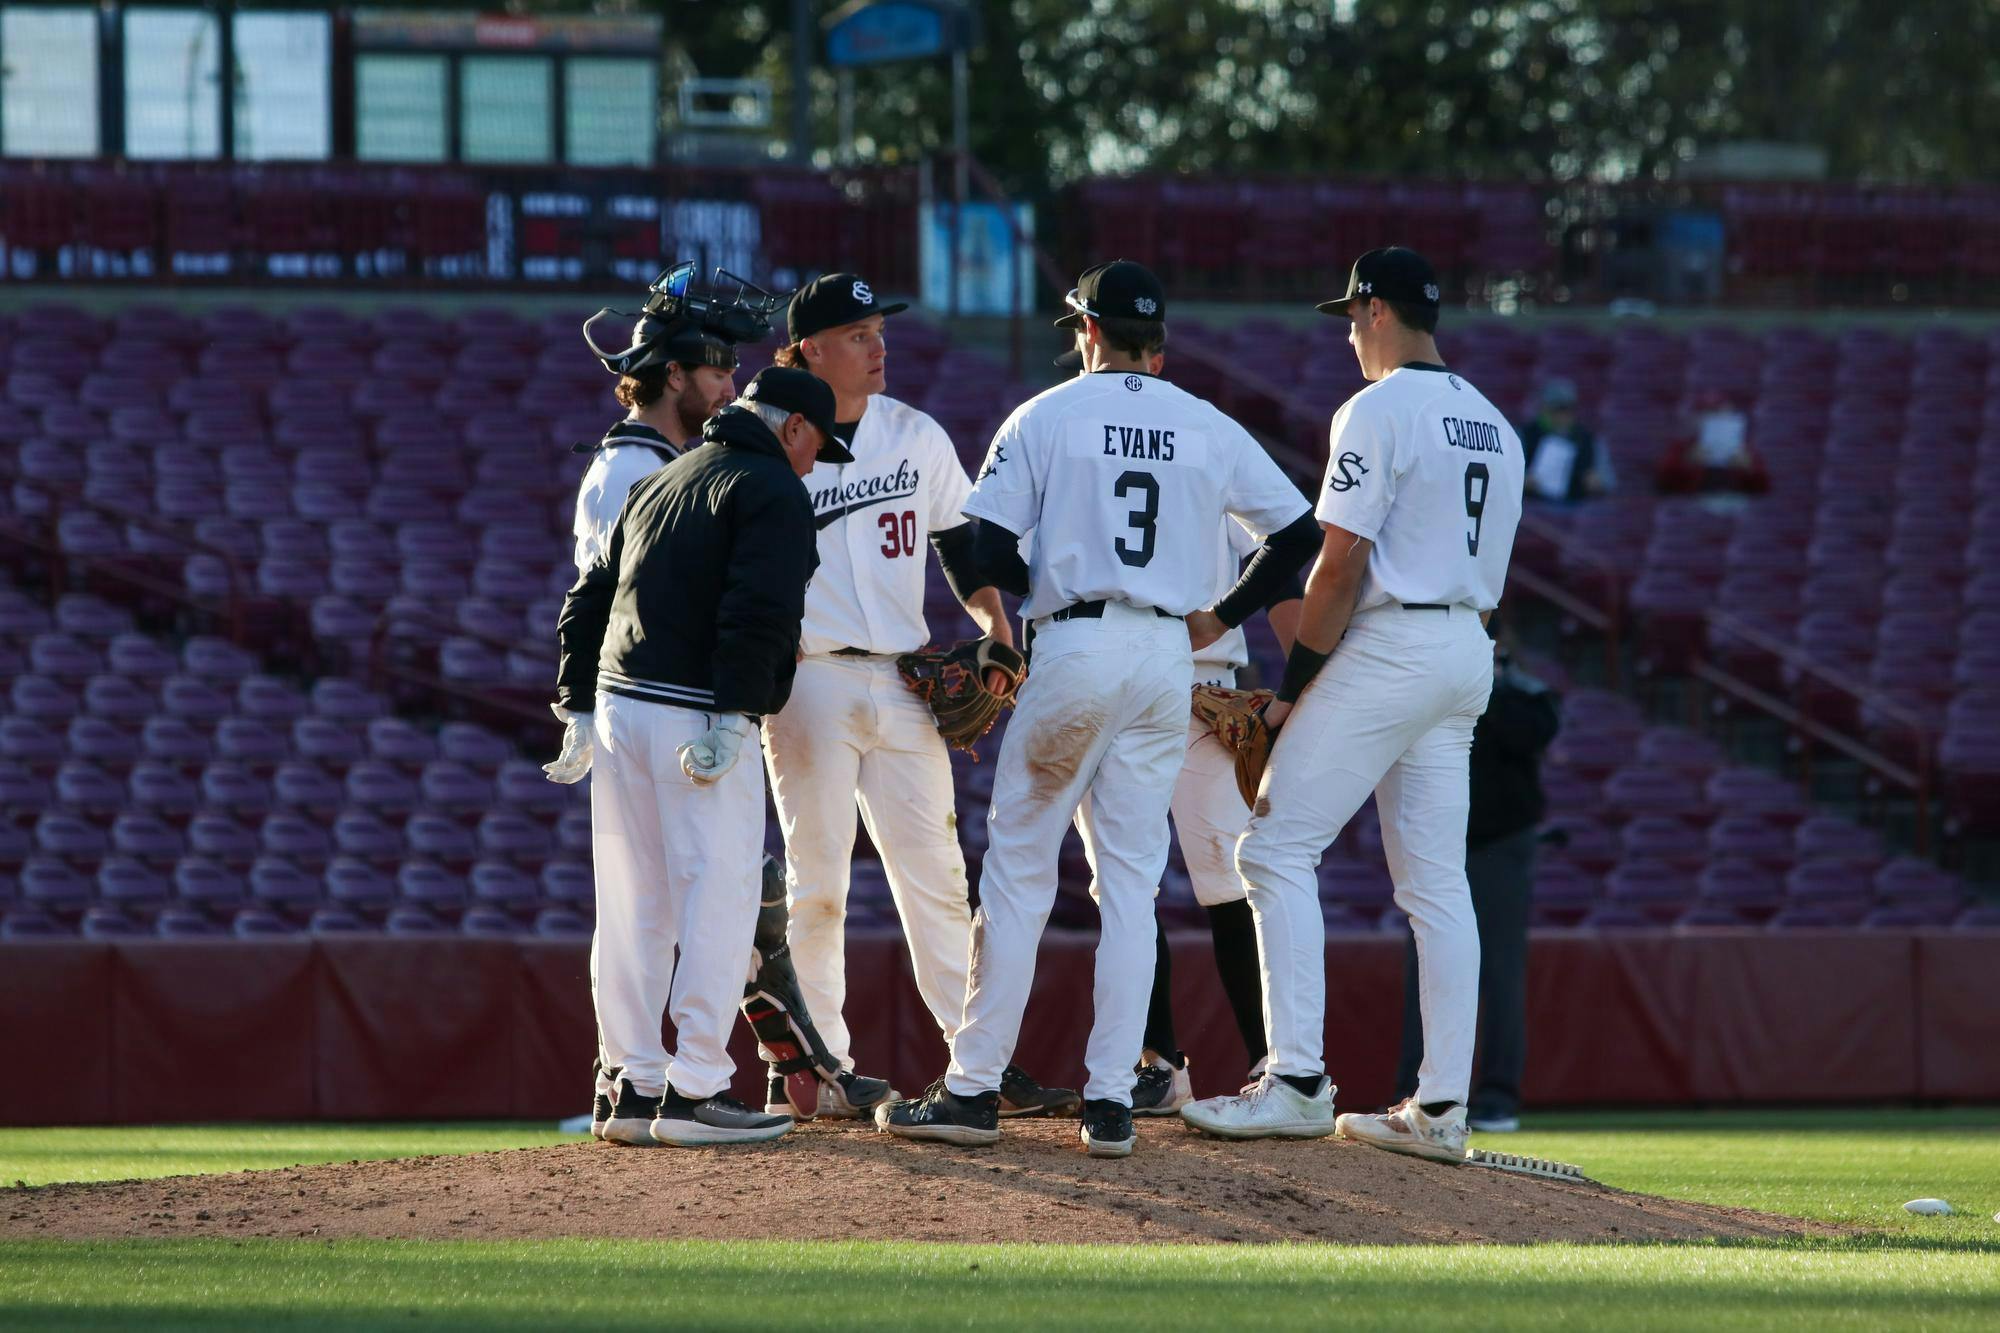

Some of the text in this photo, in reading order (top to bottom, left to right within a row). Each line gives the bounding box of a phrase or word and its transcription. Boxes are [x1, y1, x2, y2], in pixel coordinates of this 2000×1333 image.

[1104, 425, 1175, 462] EVANS
[812, 458, 919, 510] mecocks
[1465, 462, 1490, 557] 9
[878, 510, 916, 559] 30
[1115, 471, 1160, 568] 3
